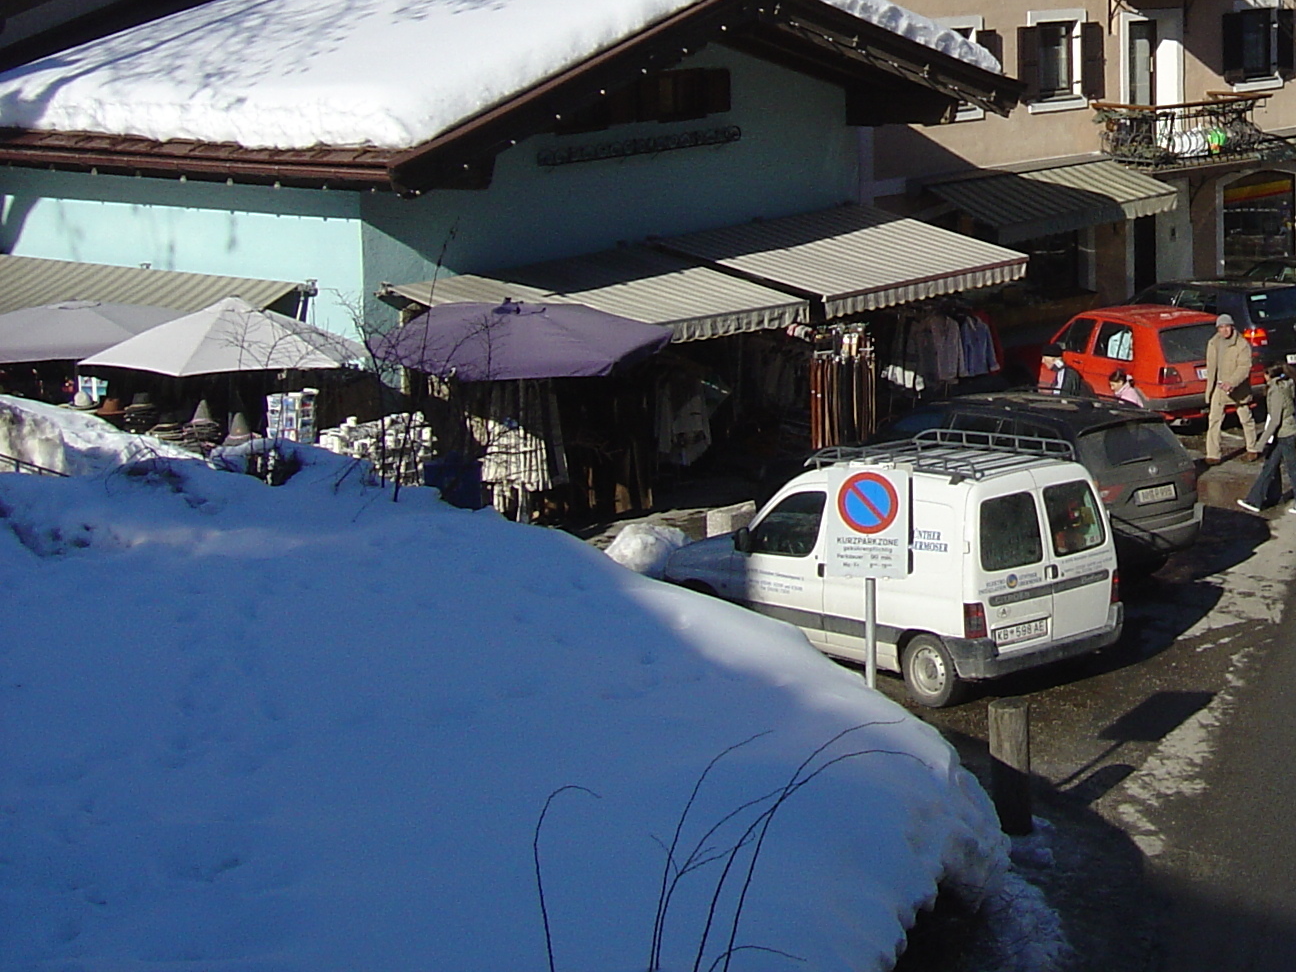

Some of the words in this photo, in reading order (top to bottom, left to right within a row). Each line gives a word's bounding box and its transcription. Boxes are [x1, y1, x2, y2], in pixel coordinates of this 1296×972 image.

[836, 537, 899, 547] KURZPARKZONE
[998, 629, 1009, 641] KB
[1034, 621, 1045, 633] AE
